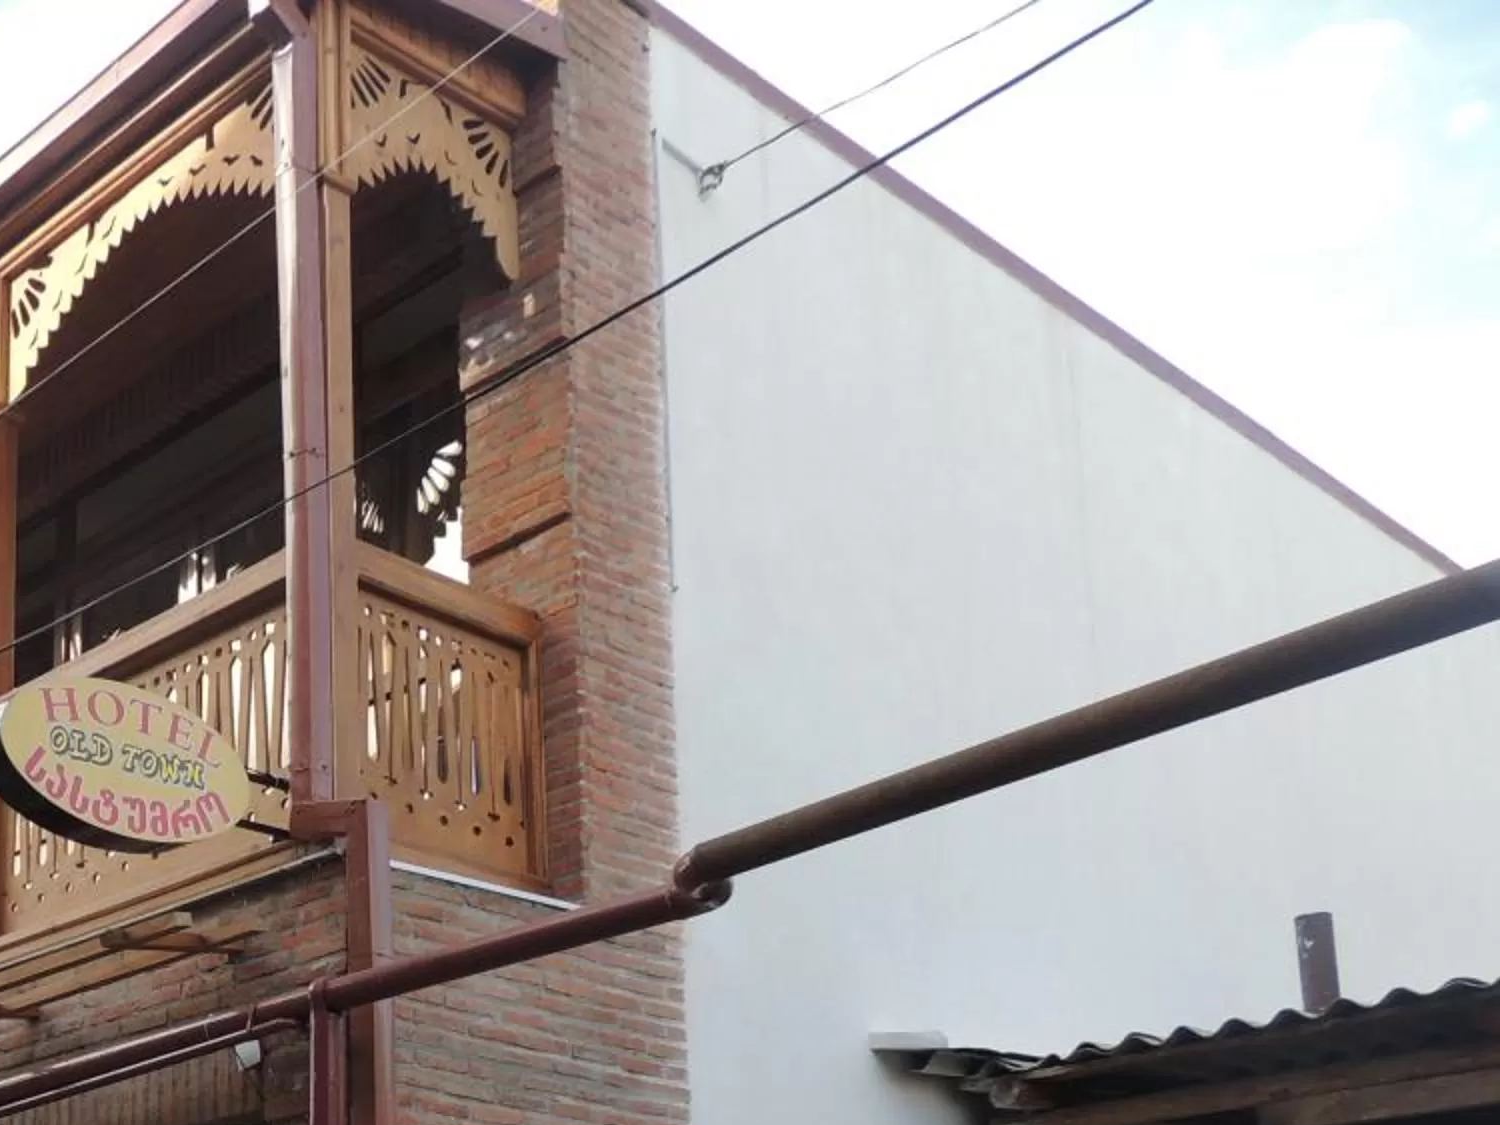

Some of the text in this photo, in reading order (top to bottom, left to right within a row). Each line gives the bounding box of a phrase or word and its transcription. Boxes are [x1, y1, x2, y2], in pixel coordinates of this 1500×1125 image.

[39, 686, 222, 769] HOTEL
[50, 725, 207, 791] OLD TOWN
[23, 745, 231, 838] სასტუმრო
